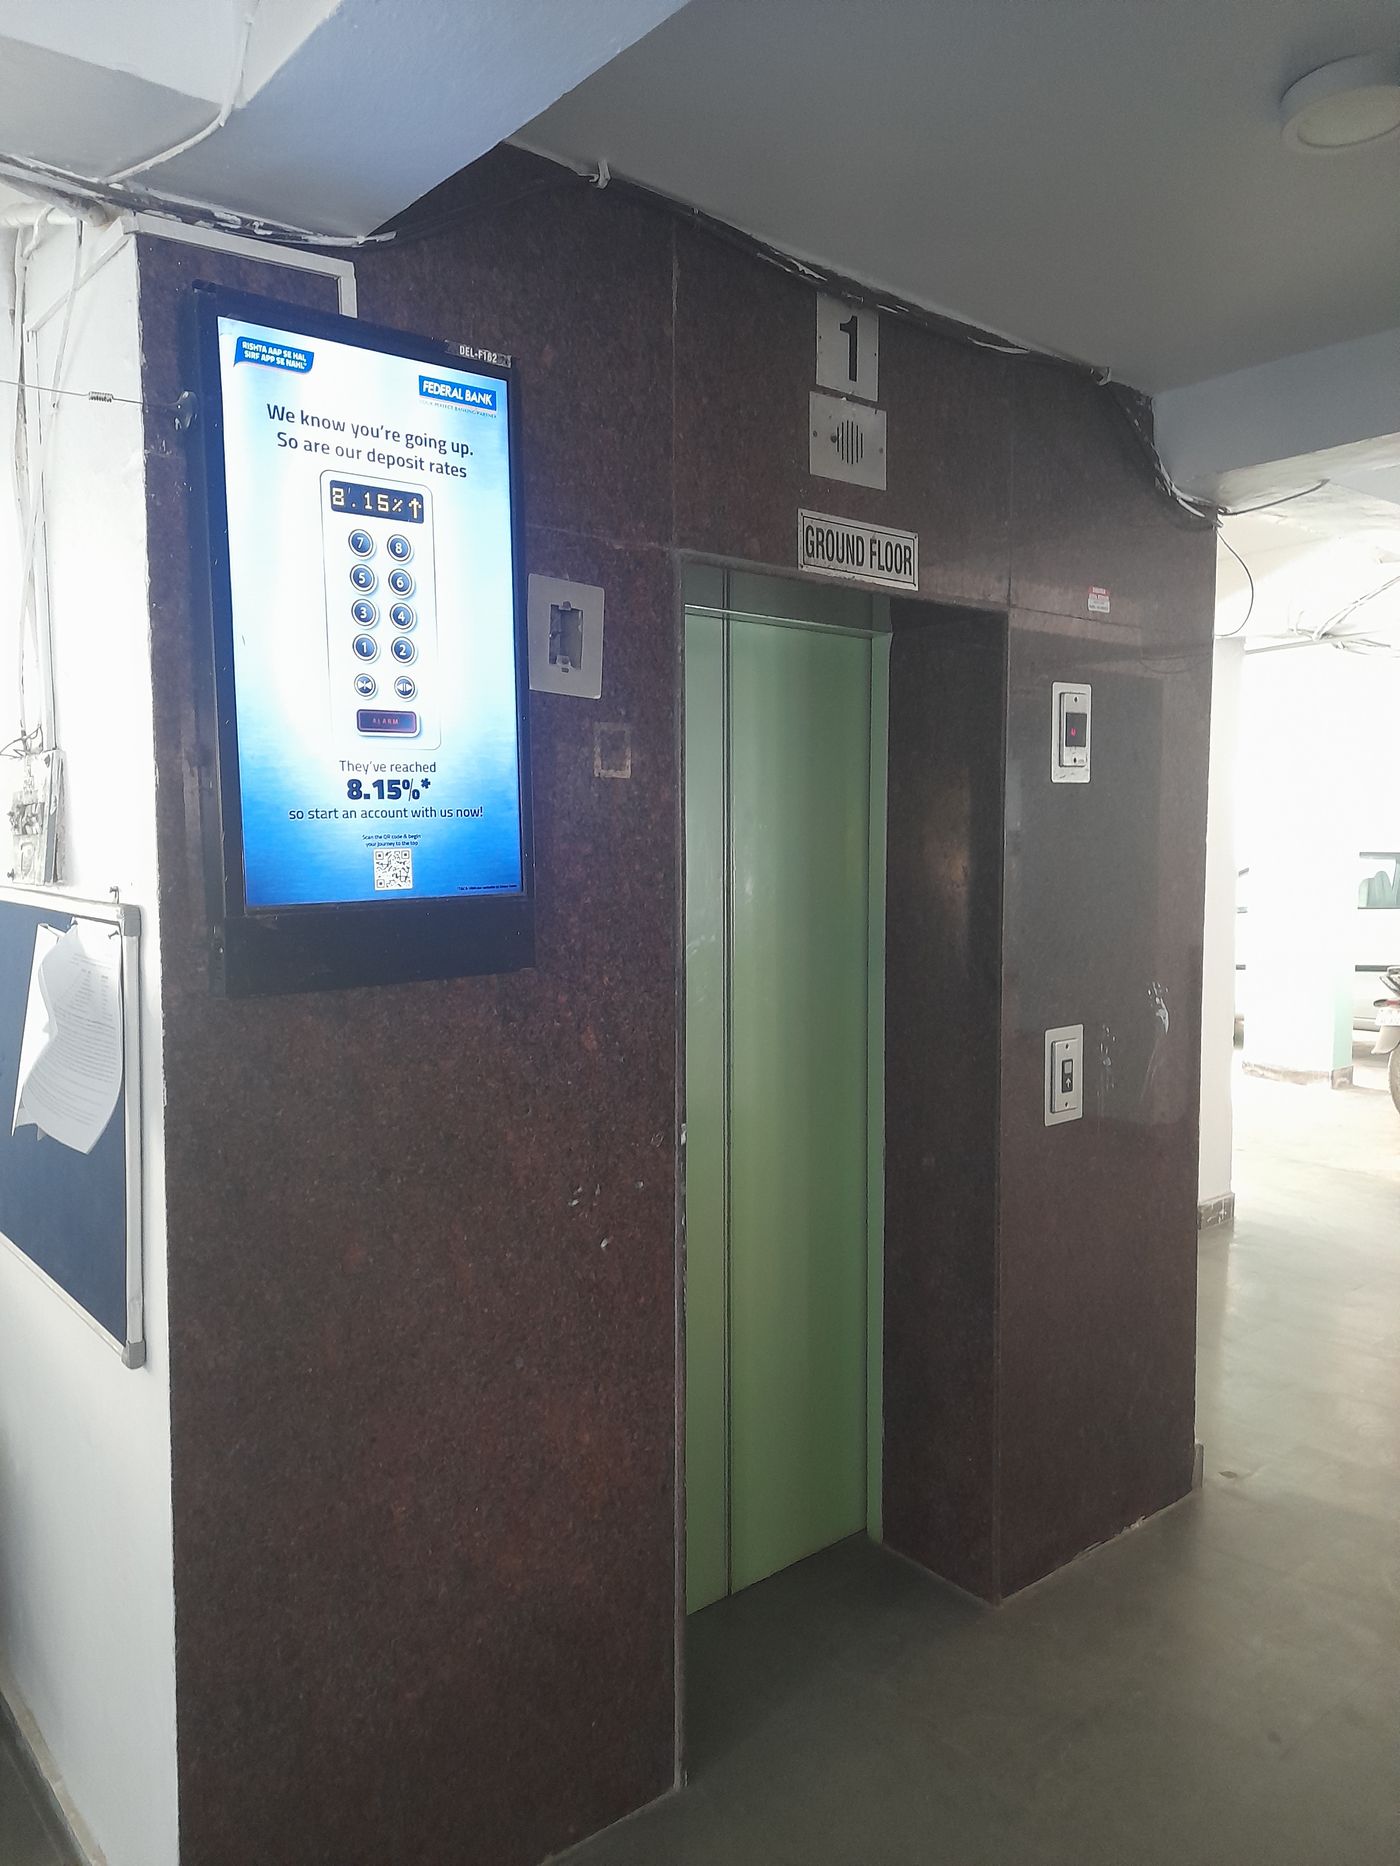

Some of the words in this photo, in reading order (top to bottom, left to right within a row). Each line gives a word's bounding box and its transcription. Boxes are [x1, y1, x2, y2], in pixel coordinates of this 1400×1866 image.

[242, 342, 267, 353] RISHTA
[268, 347, 282, 356] AAP
[283, 350, 292, 358] SE
[840, 315, 858, 382] 1
[244, 350, 260, 359] SIRF
[261, 354, 275, 363] APP
[276, 357, 285, 365] SE
[423, 381, 463, 400] FEDERAL
[465, 390, 492, 406] BANK
[266, 403, 295, 423] We
[300, 410, 346, 432] know
[350, 419, 400, 443] you're
[405, 431, 447, 456] going
[451, 441, 474, 459] up.
[277, 432, 298, 450] So
[303, 439, 330, 455] are
[335, 445, 362, 460] our
[367, 447, 424, 472] deposit
[429, 460, 467, 478] rates
[356, 536, 364, 549] 7
[394, 542, 402, 554] 8
[805, 524, 865, 567] GROUND
[869, 538, 912, 576] FLOOR
[358, 572, 365, 584] 5
[396, 576, 404, 588] 6
[360, 607, 367, 619] 3
[397, 610, 405, 622] 4
[361, 642, 368, 654] 1
[399, 644, 407, 656] 2
[339, 760, 387, 774] They've
[390, 761, 436, 773] reached
[289, 809, 304, 820] so
[307, 807, 338, 820] start
[342, 809, 357, 819] an
[360, 807, 408, 819] account
[411, 806, 437, 818] with
[439, 808, 453, 818] us
[456, 806, 483, 818] now!
